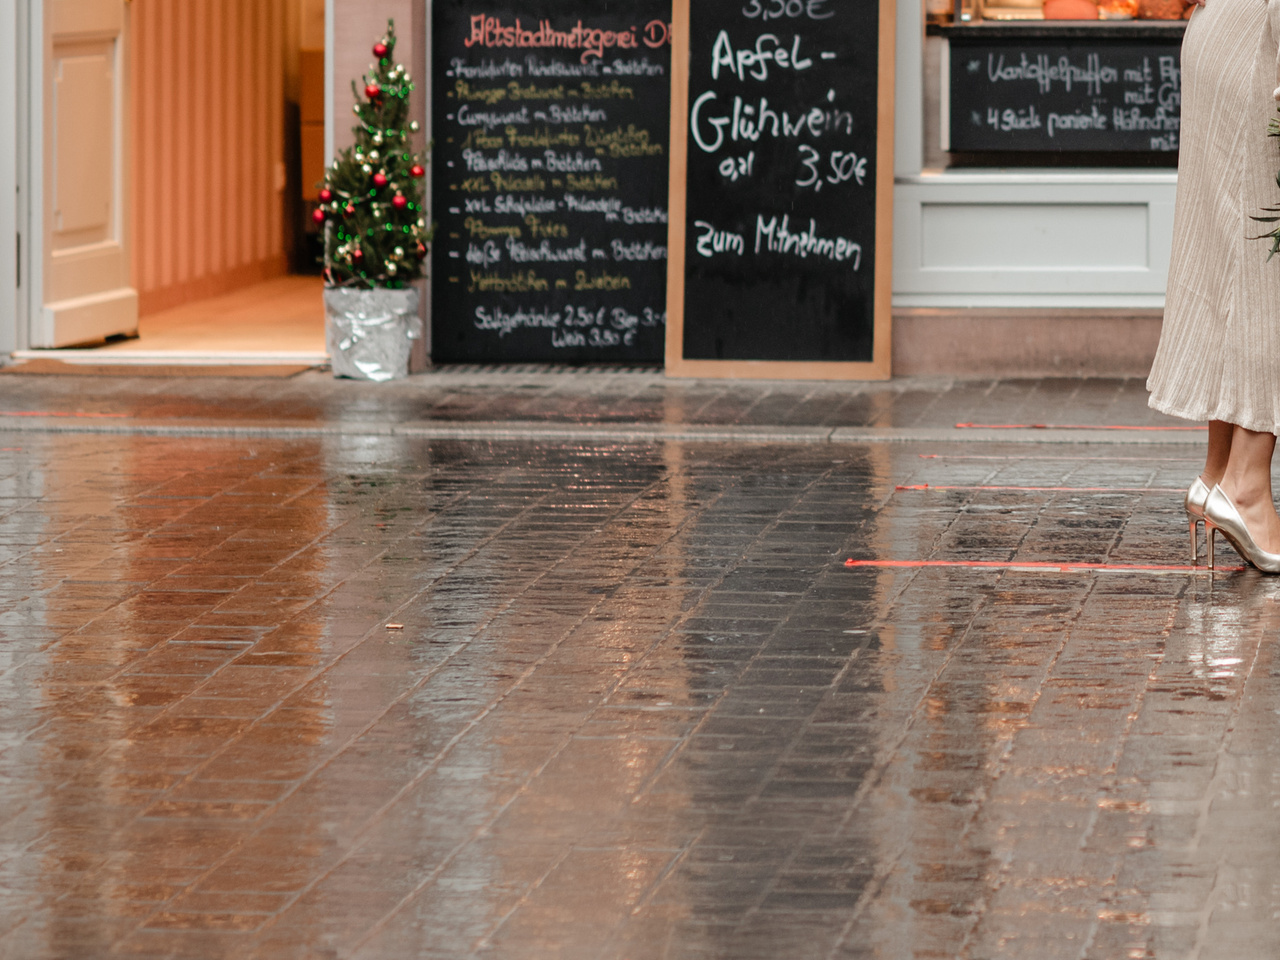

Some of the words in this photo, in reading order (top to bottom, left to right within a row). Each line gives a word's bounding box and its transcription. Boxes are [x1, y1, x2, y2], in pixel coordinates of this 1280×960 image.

[464, 13, 638, 64] Altstadtmetzgerei
[1124, 56, 1153, 82] mit
[1124, 84, 1155, 105] mit
[691, 89, 852, 152] Glühwein
[987, 107, 999, 130] 4
[1001, 105, 1042, 132] Stück
[1047, 105, 1107, 137] panierte
[754, 213, 861, 271] Mitnehmen
[552, 330, 586, 348] Wein
